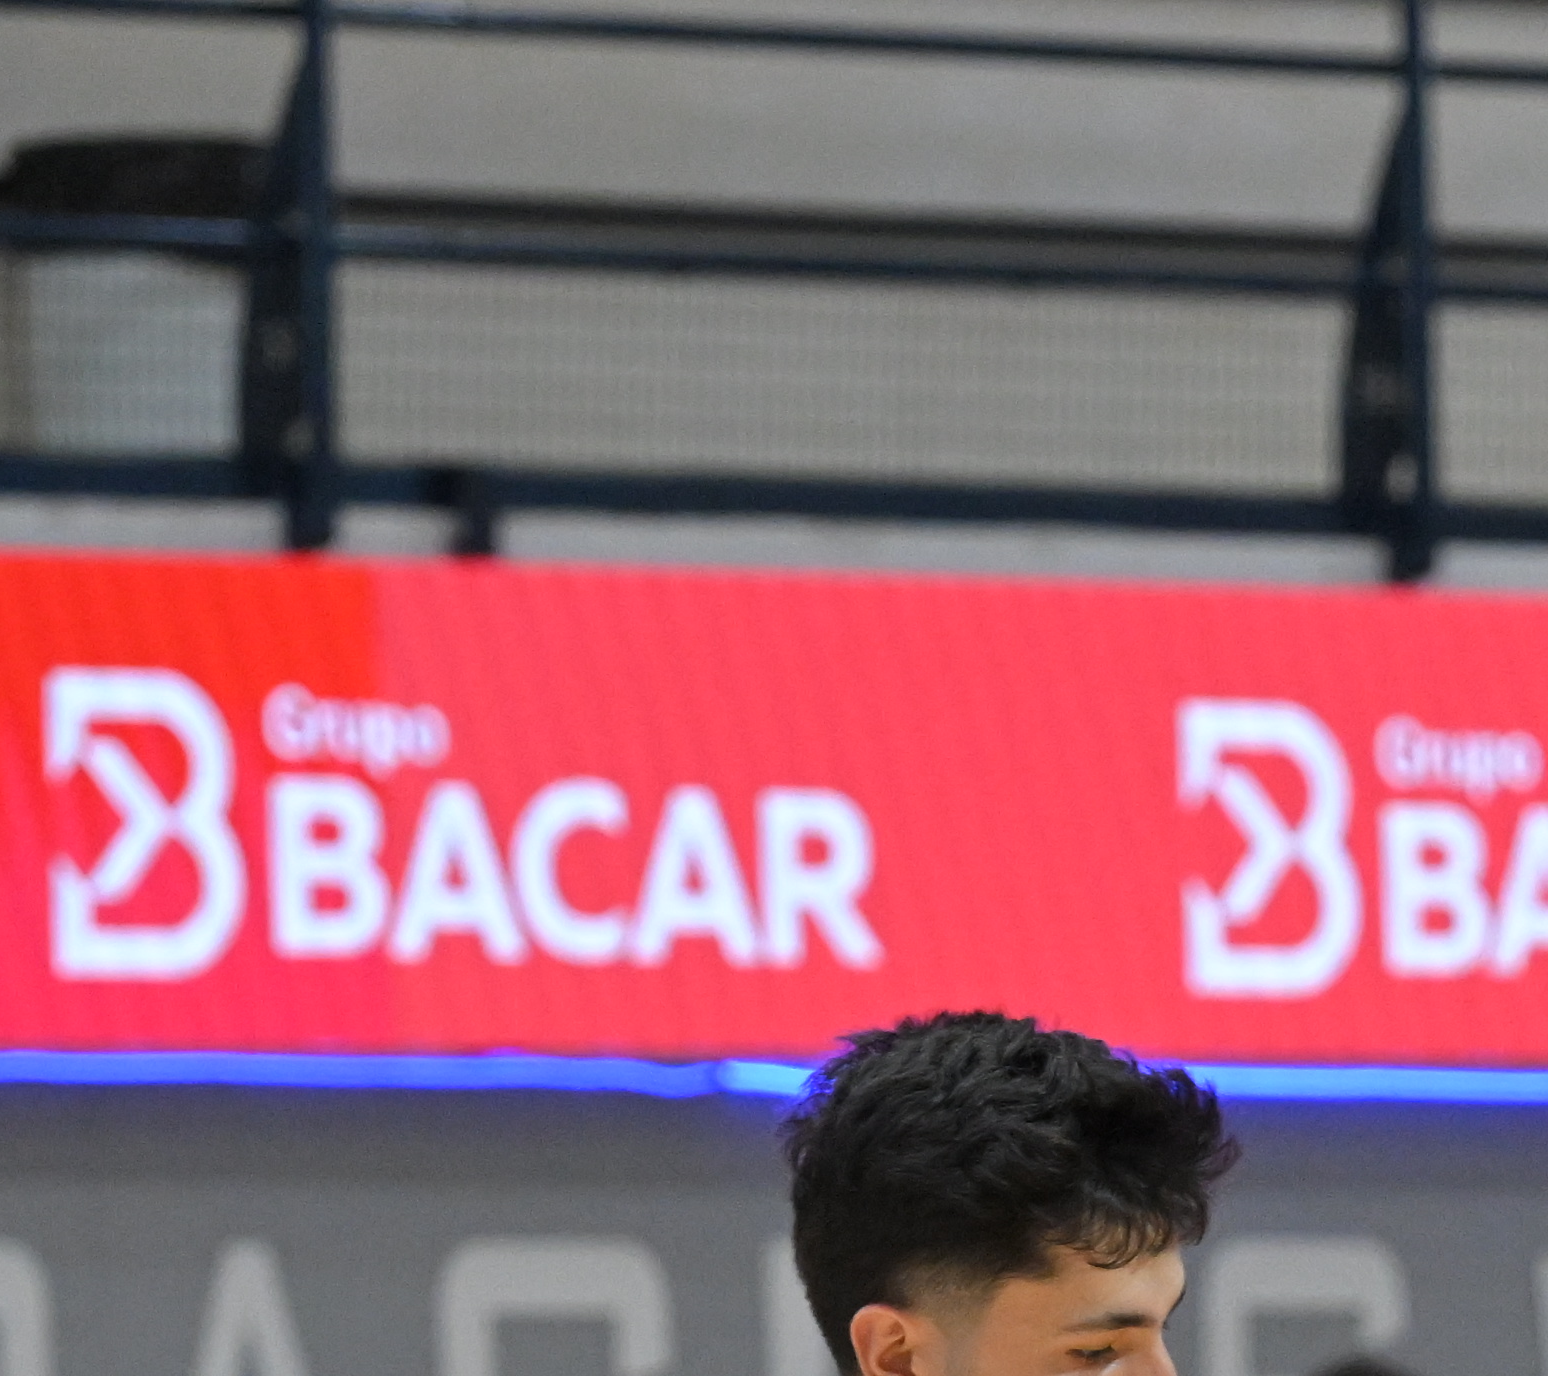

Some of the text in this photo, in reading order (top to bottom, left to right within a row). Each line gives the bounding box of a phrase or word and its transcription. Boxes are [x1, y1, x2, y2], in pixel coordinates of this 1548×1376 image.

[262, 682, 450, 772] Grupo
[1374, 715, 1543, 796] Grupo
[267, 773, 884, 968] BACAR
